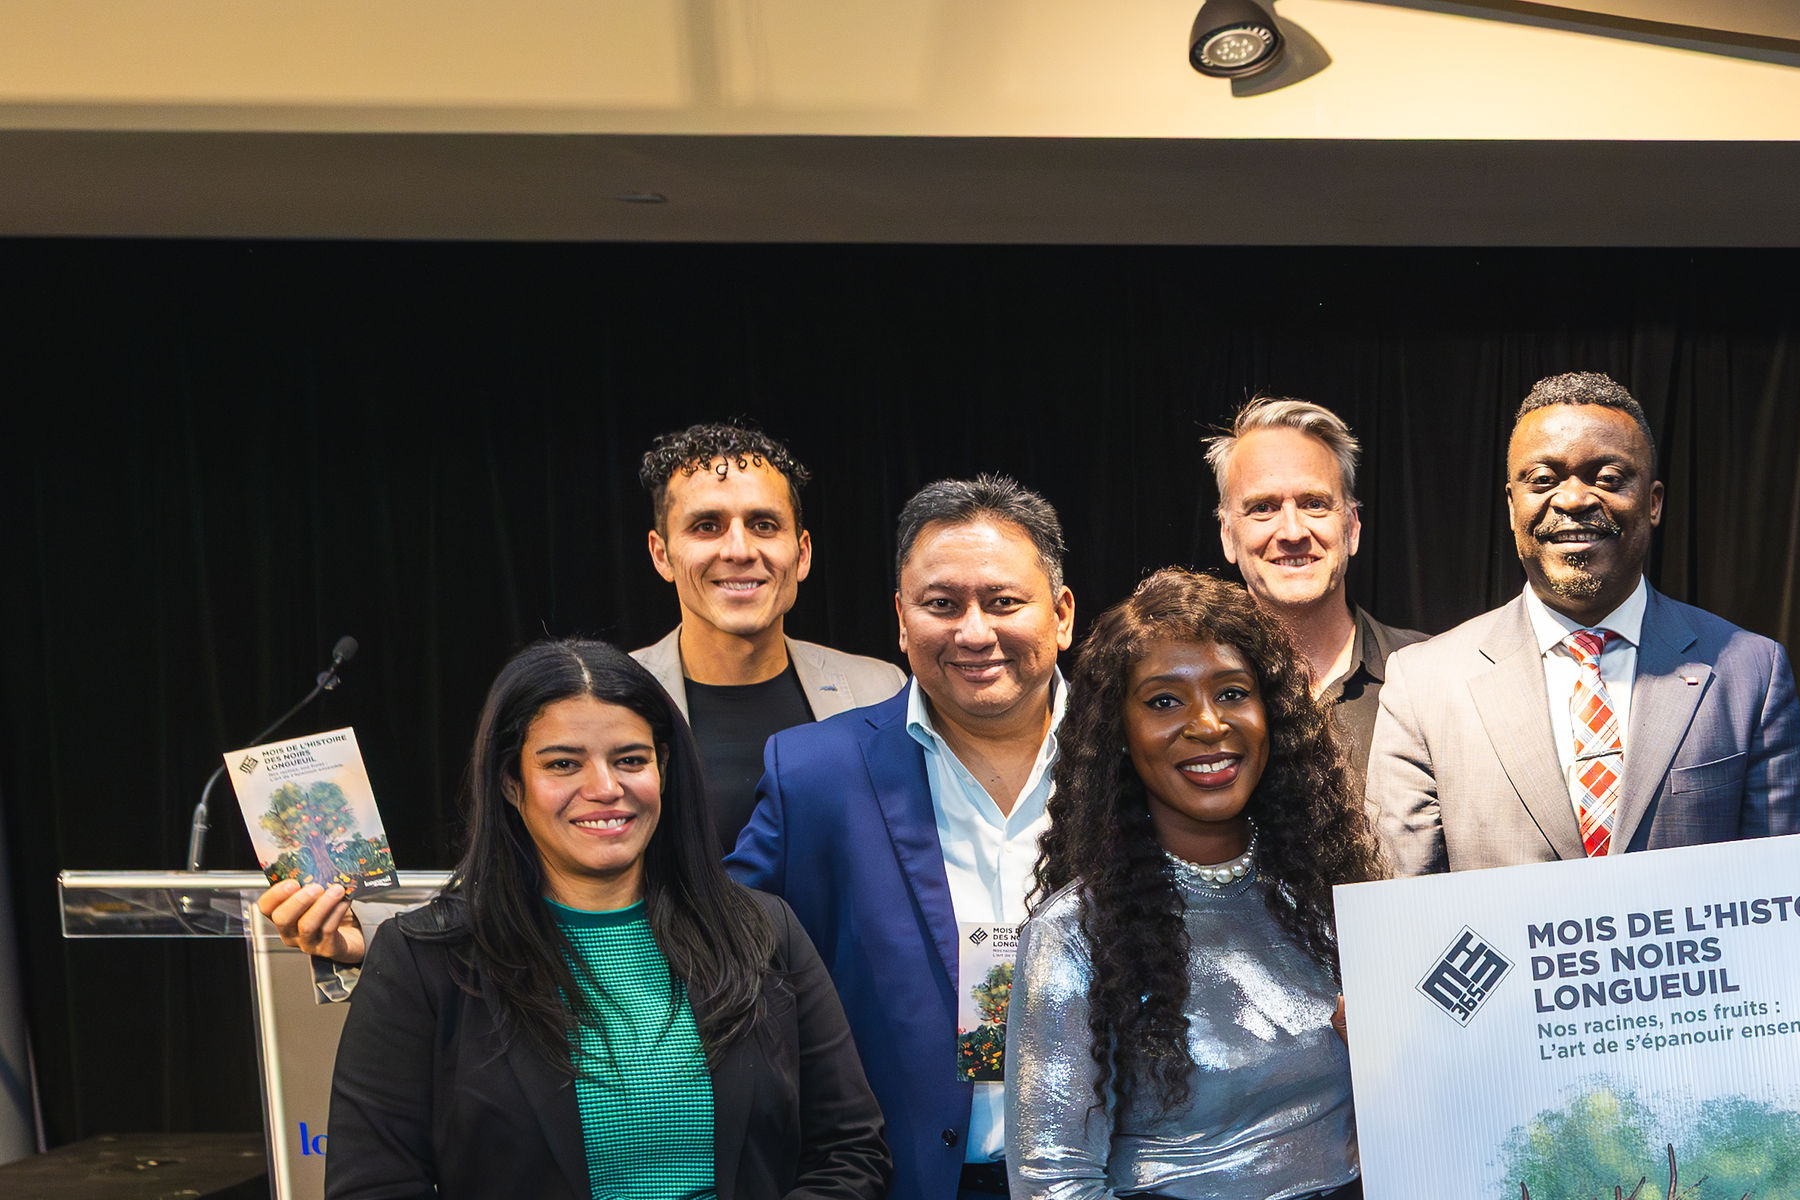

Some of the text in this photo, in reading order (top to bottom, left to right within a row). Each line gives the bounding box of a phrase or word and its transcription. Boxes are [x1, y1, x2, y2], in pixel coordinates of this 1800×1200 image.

[262, 748, 285, 758] MOIS
[286, 744, 298, 753] DE
[264, 757, 282, 765] DES
[283, 750, 311, 760] NOIRS
[266, 757, 317, 772] LONGUEUIL
[1527, 915, 1617, 949] MOIS
[1627, 909, 1675, 938] DE
[1530, 936, 1722, 981] DES NOIRS
[1534, 968, 1740, 1013] LONGUEUIL
[1537, 1000, 1781, 1039] Nos racines, nos fruits :
[1593, 1037, 1618, 1055] de
